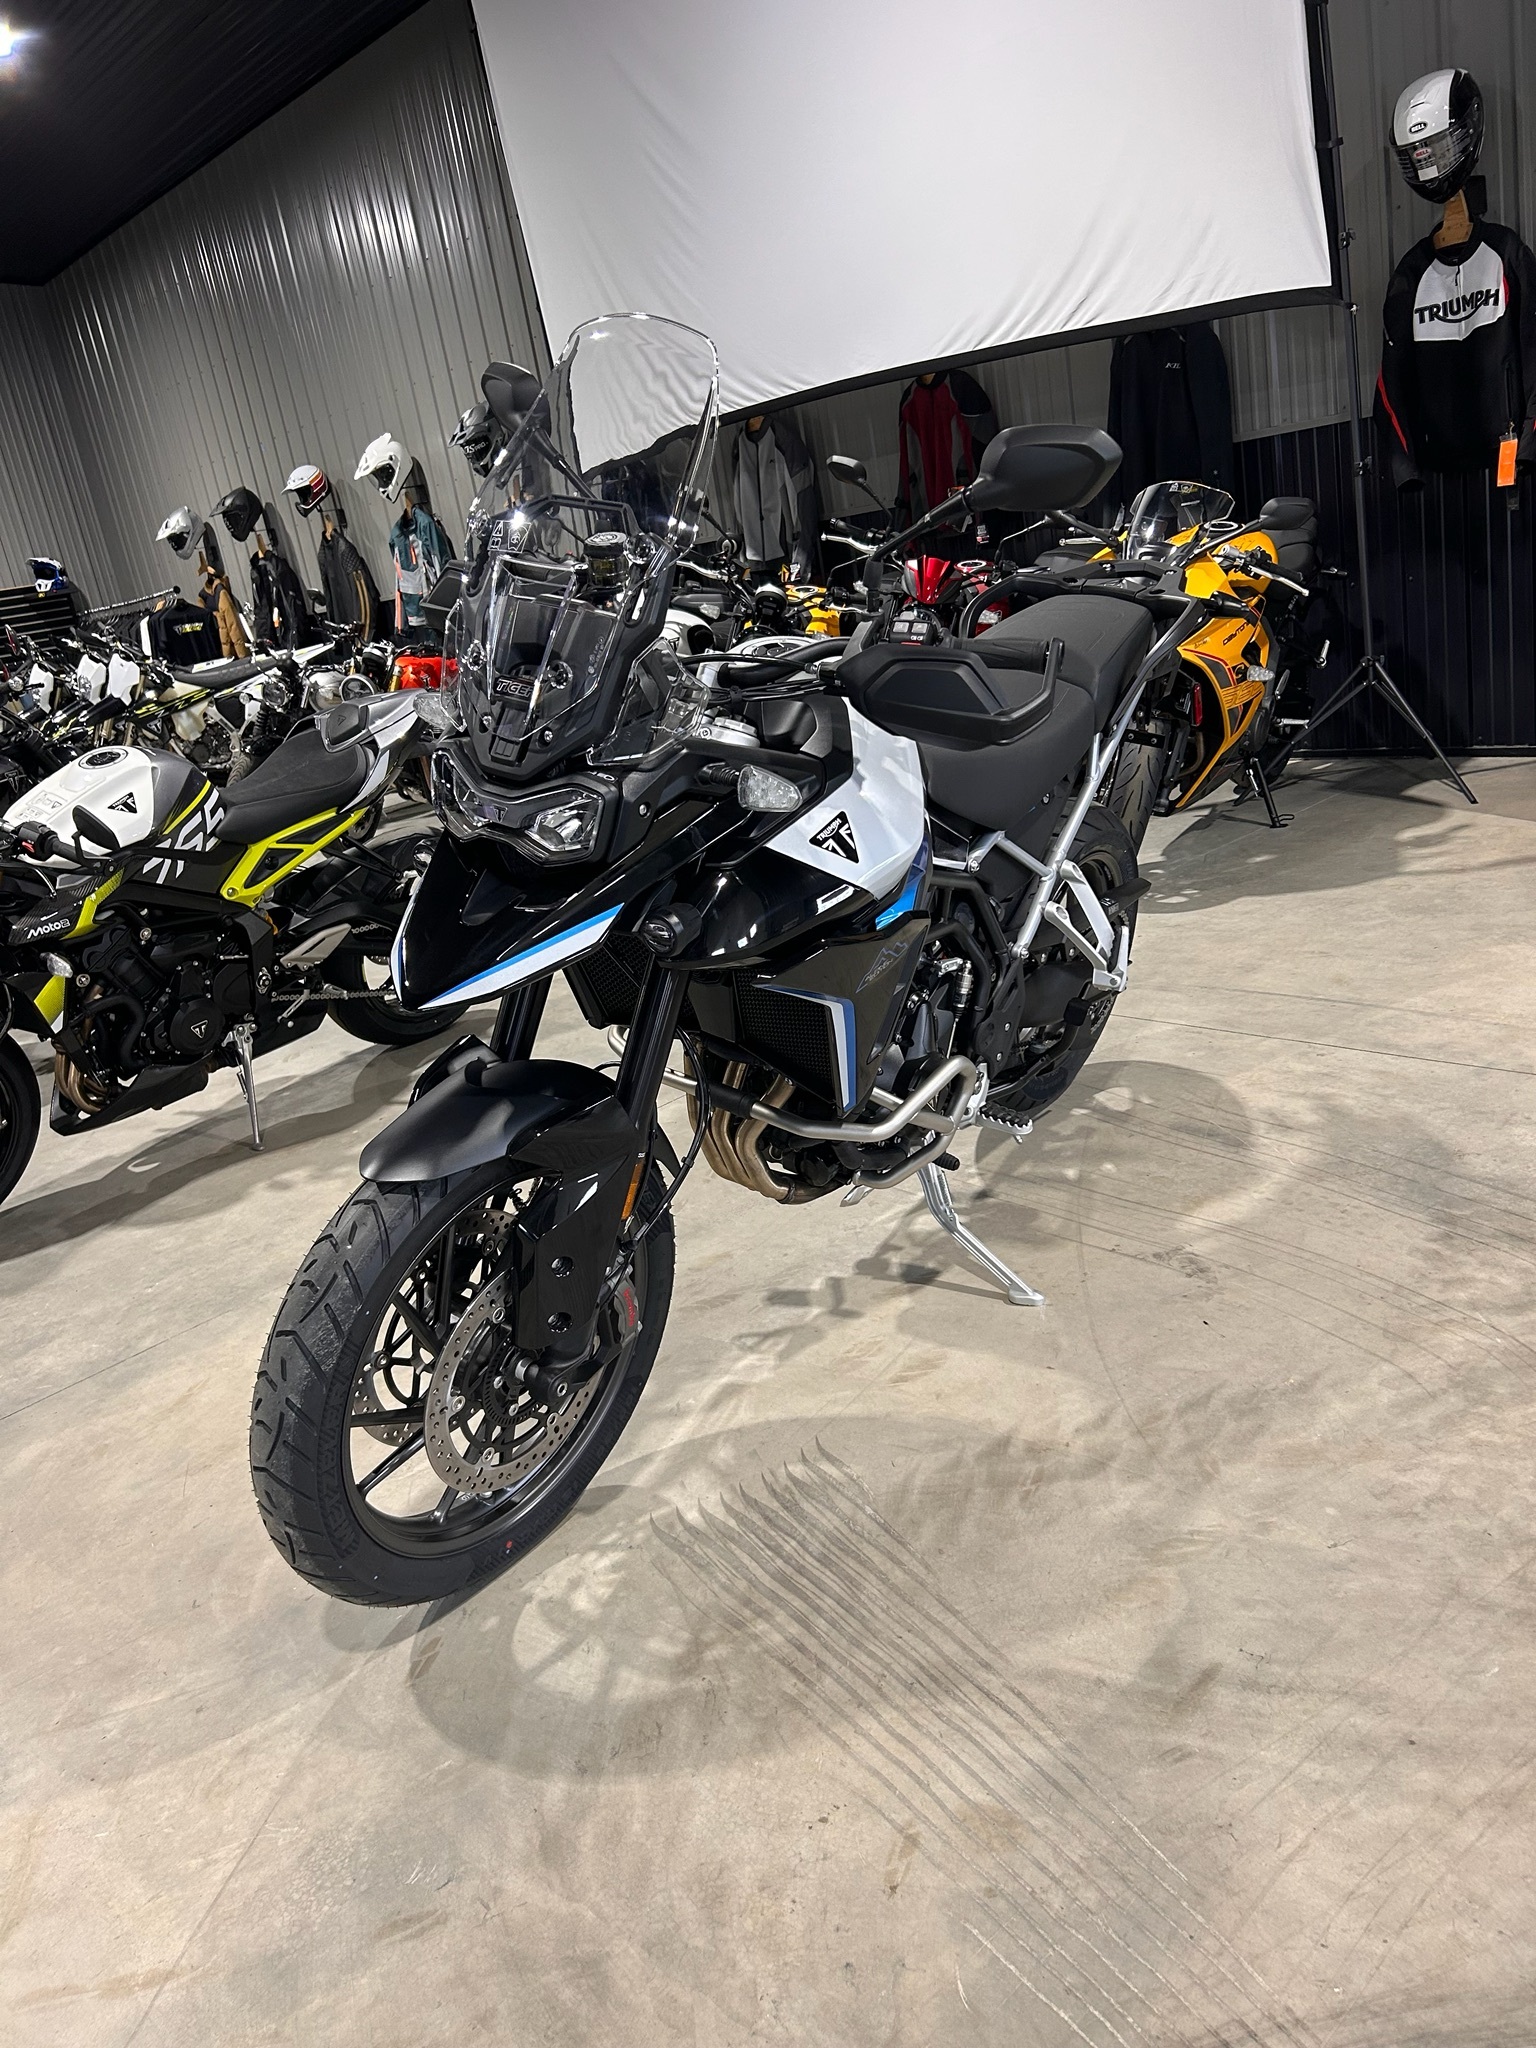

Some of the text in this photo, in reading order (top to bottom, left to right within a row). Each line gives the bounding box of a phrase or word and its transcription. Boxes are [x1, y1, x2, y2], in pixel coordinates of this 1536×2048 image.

[1411, 123, 1425, 133] BELL
[1415, 149, 1429, 157] BELL
[1414, 288, 1500, 324] TRIUMPH
[816, 817, 842, 841] TRIUMPH
[27, 918, 71, 943] Moto2
